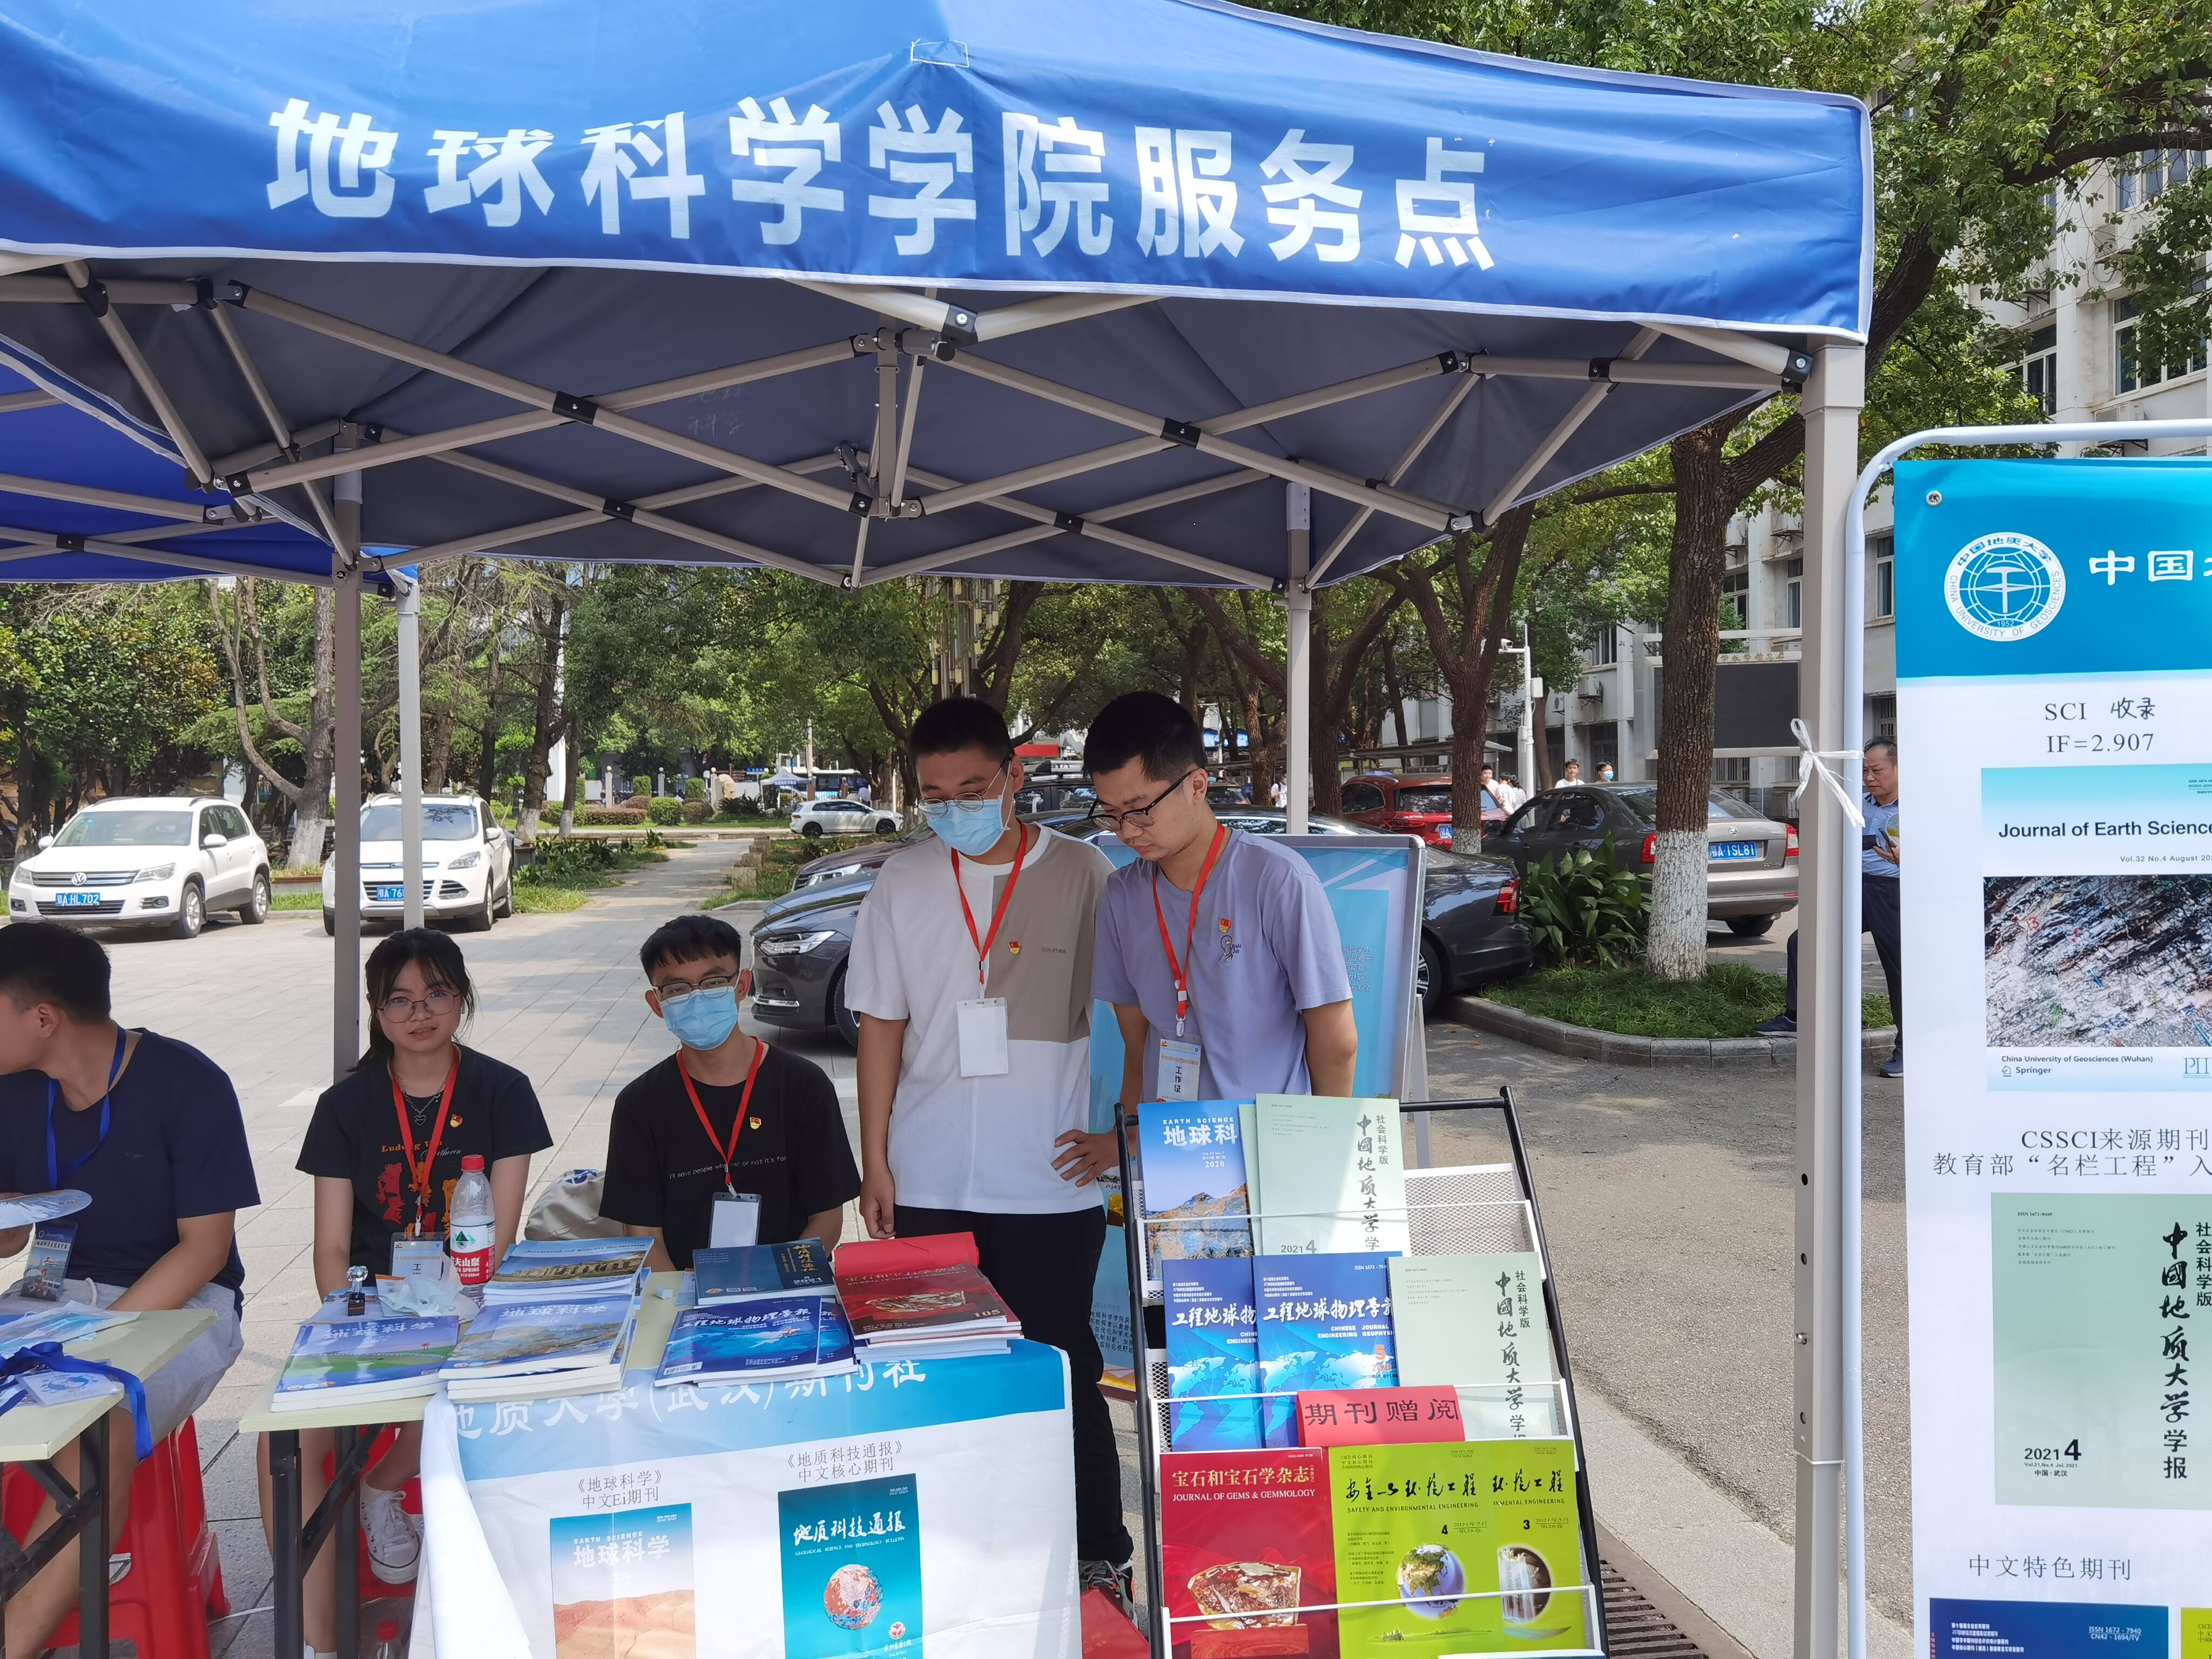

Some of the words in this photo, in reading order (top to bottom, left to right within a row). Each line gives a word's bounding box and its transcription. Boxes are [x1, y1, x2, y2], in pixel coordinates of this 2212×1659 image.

[266, 96, 1495, 271] 地球科学学院服务点
[1948, 575, 1959, 603] CHINA
[1955, 606, 2006, 638] UNIVERSITY
[2012, 626, 2025, 637] OF
[2030, 570, 2062, 630] GEOSCIENCES
[2045, 702, 2087, 721] SCI
[2110, 697, 2156, 720] 收录
[2046, 732, 2154, 753] IF=2.907
[1998, 823, 2066, 838] Journal
[2072, 822, 2090, 837] of
[2094, 820, 2142, 836] Earth
[2120, 855, 2146, 863] Vol.32
[2169, 854, 2198, 863] August
[2015, 1066, 2052, 1075] Springer
[2024, 1055, 2061, 1064] University
[2073, 1055, 2119, 1063] Geosciences
[2120, 1055, 2154, 1063] (Wuhan)
[1174, 1065, 1183, 1093] 工作证
[1163, 1123, 1238, 1147] 地球科
[1375, 1114, 1389, 1165] 社会科学版
[2021, 1128, 2208, 1151] CSSCI来源期刊
[692, 1165, 713, 1176] people
[1205, 1160, 1225, 1168] 2020
[1280, 1245, 1303, 1253] 2021
[1305, 1239, 1317, 1253] 4
[2195, 1222, 2212, 1307] 社会科学版
[1515, 1270, 1530, 1328] 社会科学版
[974, 1309, 1001, 1318] 105
[1375, 1344, 1386, 1360] 5
[1495, 1271, 1526, 1438] 中國地质大学学
[1304, 1398, 1459, 1426] 期刊赠阅
[786, 1440, 903, 1469] 《地质科技通报》
[2024, 1447, 2060, 1460] 2021
[2064, 1439, 2082, 1461] 4
[798, 1456, 894, 1483] 中文核心期刊
[1172, 1466, 1310, 1487] 宝石和宝石学杂志
[578, 1469, 662, 1494] 《地球科学》
[582, 1486, 659, 1510] 中文Ei期刊
[1172, 1493, 1212, 1502] JOURNAL
[1213, 1492, 1225, 1500] OF
[1226, 1491, 1250, 1500] GEMS
[1260, 1489, 1316, 1499] GEMMOLOGY
[1386, 1504, 1437, 1512] ENVIRONMENTAL
[1438, 1502, 1479, 1510] ENGINEERING
[793, 1510, 906, 1547] 地质科技通报
[1441, 1524, 1448, 1535] 4
[1523, 1519, 1530, 1530] 3
[574, 1536, 601, 1545] EARTH
[606, 1530, 643, 1541] SCIENCE
[573, 1534, 670, 1568] 地球科学
[1969, 1554, 2131, 1581] 中文特色期刊
